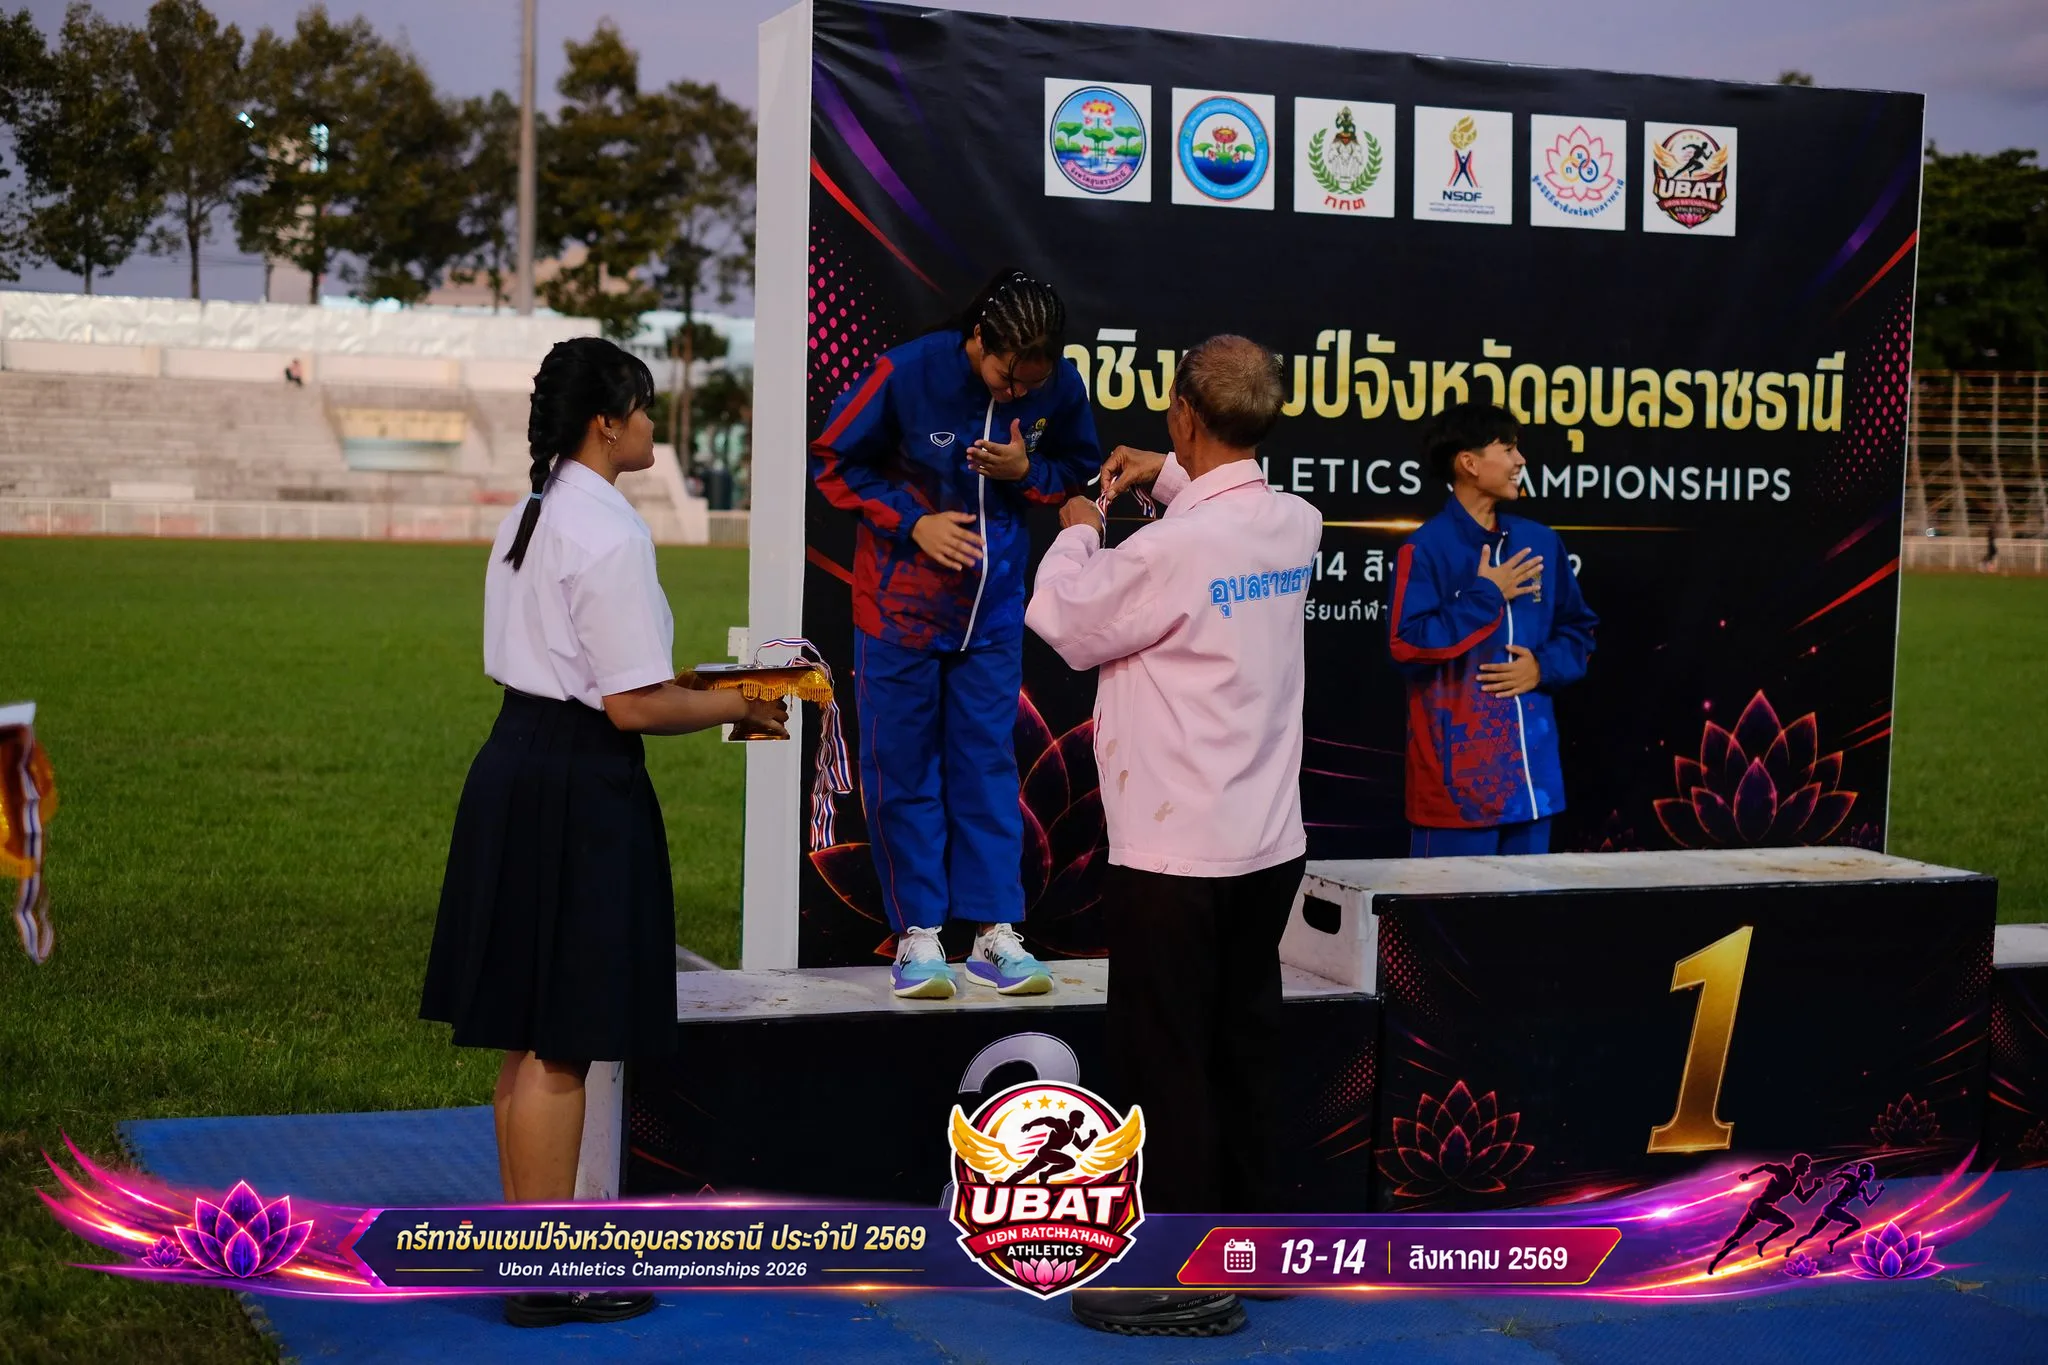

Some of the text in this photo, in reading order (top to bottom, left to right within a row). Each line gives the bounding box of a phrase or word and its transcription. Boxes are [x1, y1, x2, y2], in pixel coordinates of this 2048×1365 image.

[1442, 190, 1483, 202] NSDF
[1659, 179, 1722, 201] UBAT
[1446, 463, 1791, 502] AMPIONSHIPS
[1647, 926, 1754, 1154] 1
